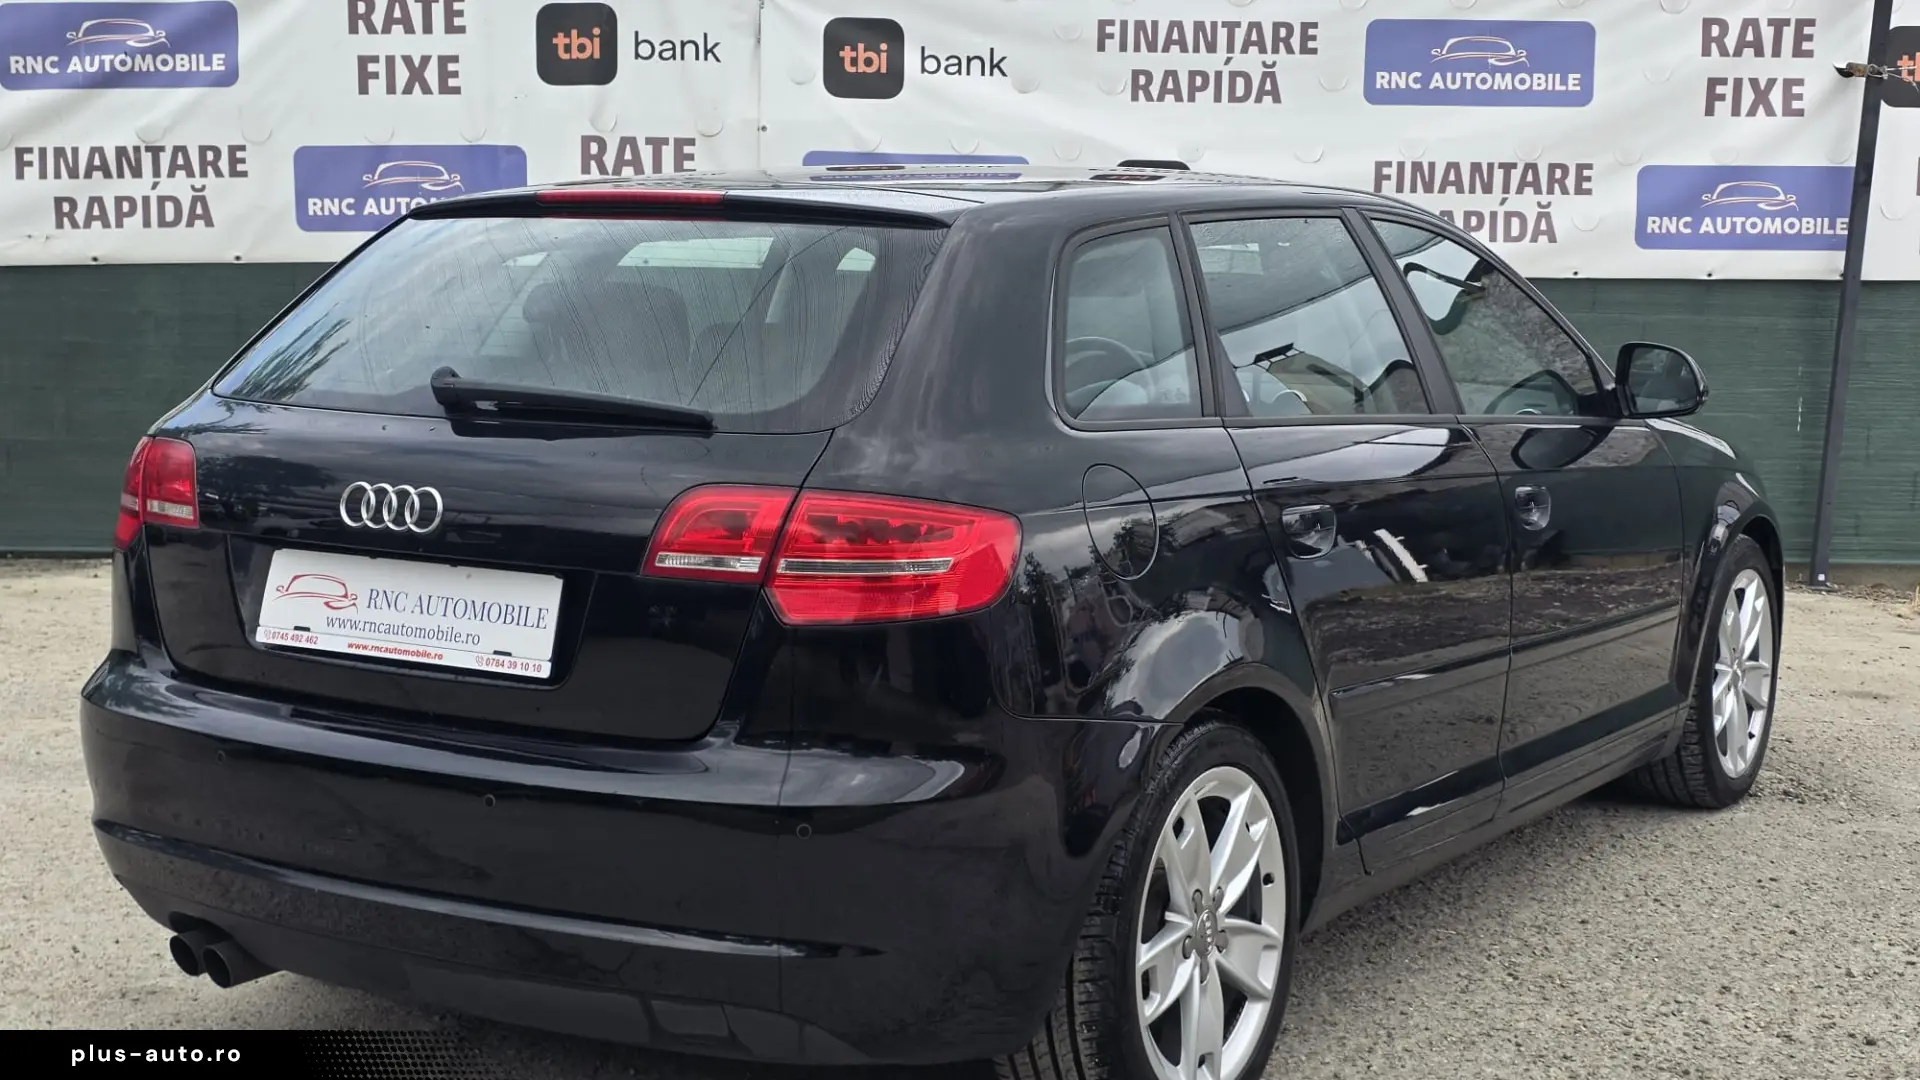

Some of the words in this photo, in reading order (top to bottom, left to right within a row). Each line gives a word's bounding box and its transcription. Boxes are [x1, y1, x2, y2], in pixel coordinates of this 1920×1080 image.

[348, 0, 466, 34] RATE
[553, 28, 601, 60] tbi
[634, 31, 721, 62] bank
[1702, 17, 1816, 58] RATE
[10, 55, 59, 74] RNC
[67, 53, 226, 73] AUTOMOBILE
[357, 55, 462, 95] FIXE
[839, 43, 887, 73] tbi
[920, 46, 1008, 77] bank
[1375, 72, 1422, 89] RNC
[1429, 72, 1581, 90] AUTOMOBILE
[1704, 77, 1805, 117] FIXE
[581, 135, 697, 176] RATE
[308, 198, 355, 216] RNC
[1647, 217, 1692, 234] RNC
[1699, 217, 1849, 235] AUTOMOBILE
[366, 588, 408, 613] RNC
[411, 593, 549, 629] AUTOMOBILE
[272, 632, 289, 641] 0745
[290, 634, 303, 643] 492
[305, 635, 319, 645] 462
[326, 616, 480, 646] www.rncautomobile.ro
[347, 641, 444, 661] www.rncautomobile.ro
[485, 657, 505, 668] 0784
[507, 659, 517, 670] 39
[520, 661, 530, 672] 10
[532, 663, 542, 673] 10
